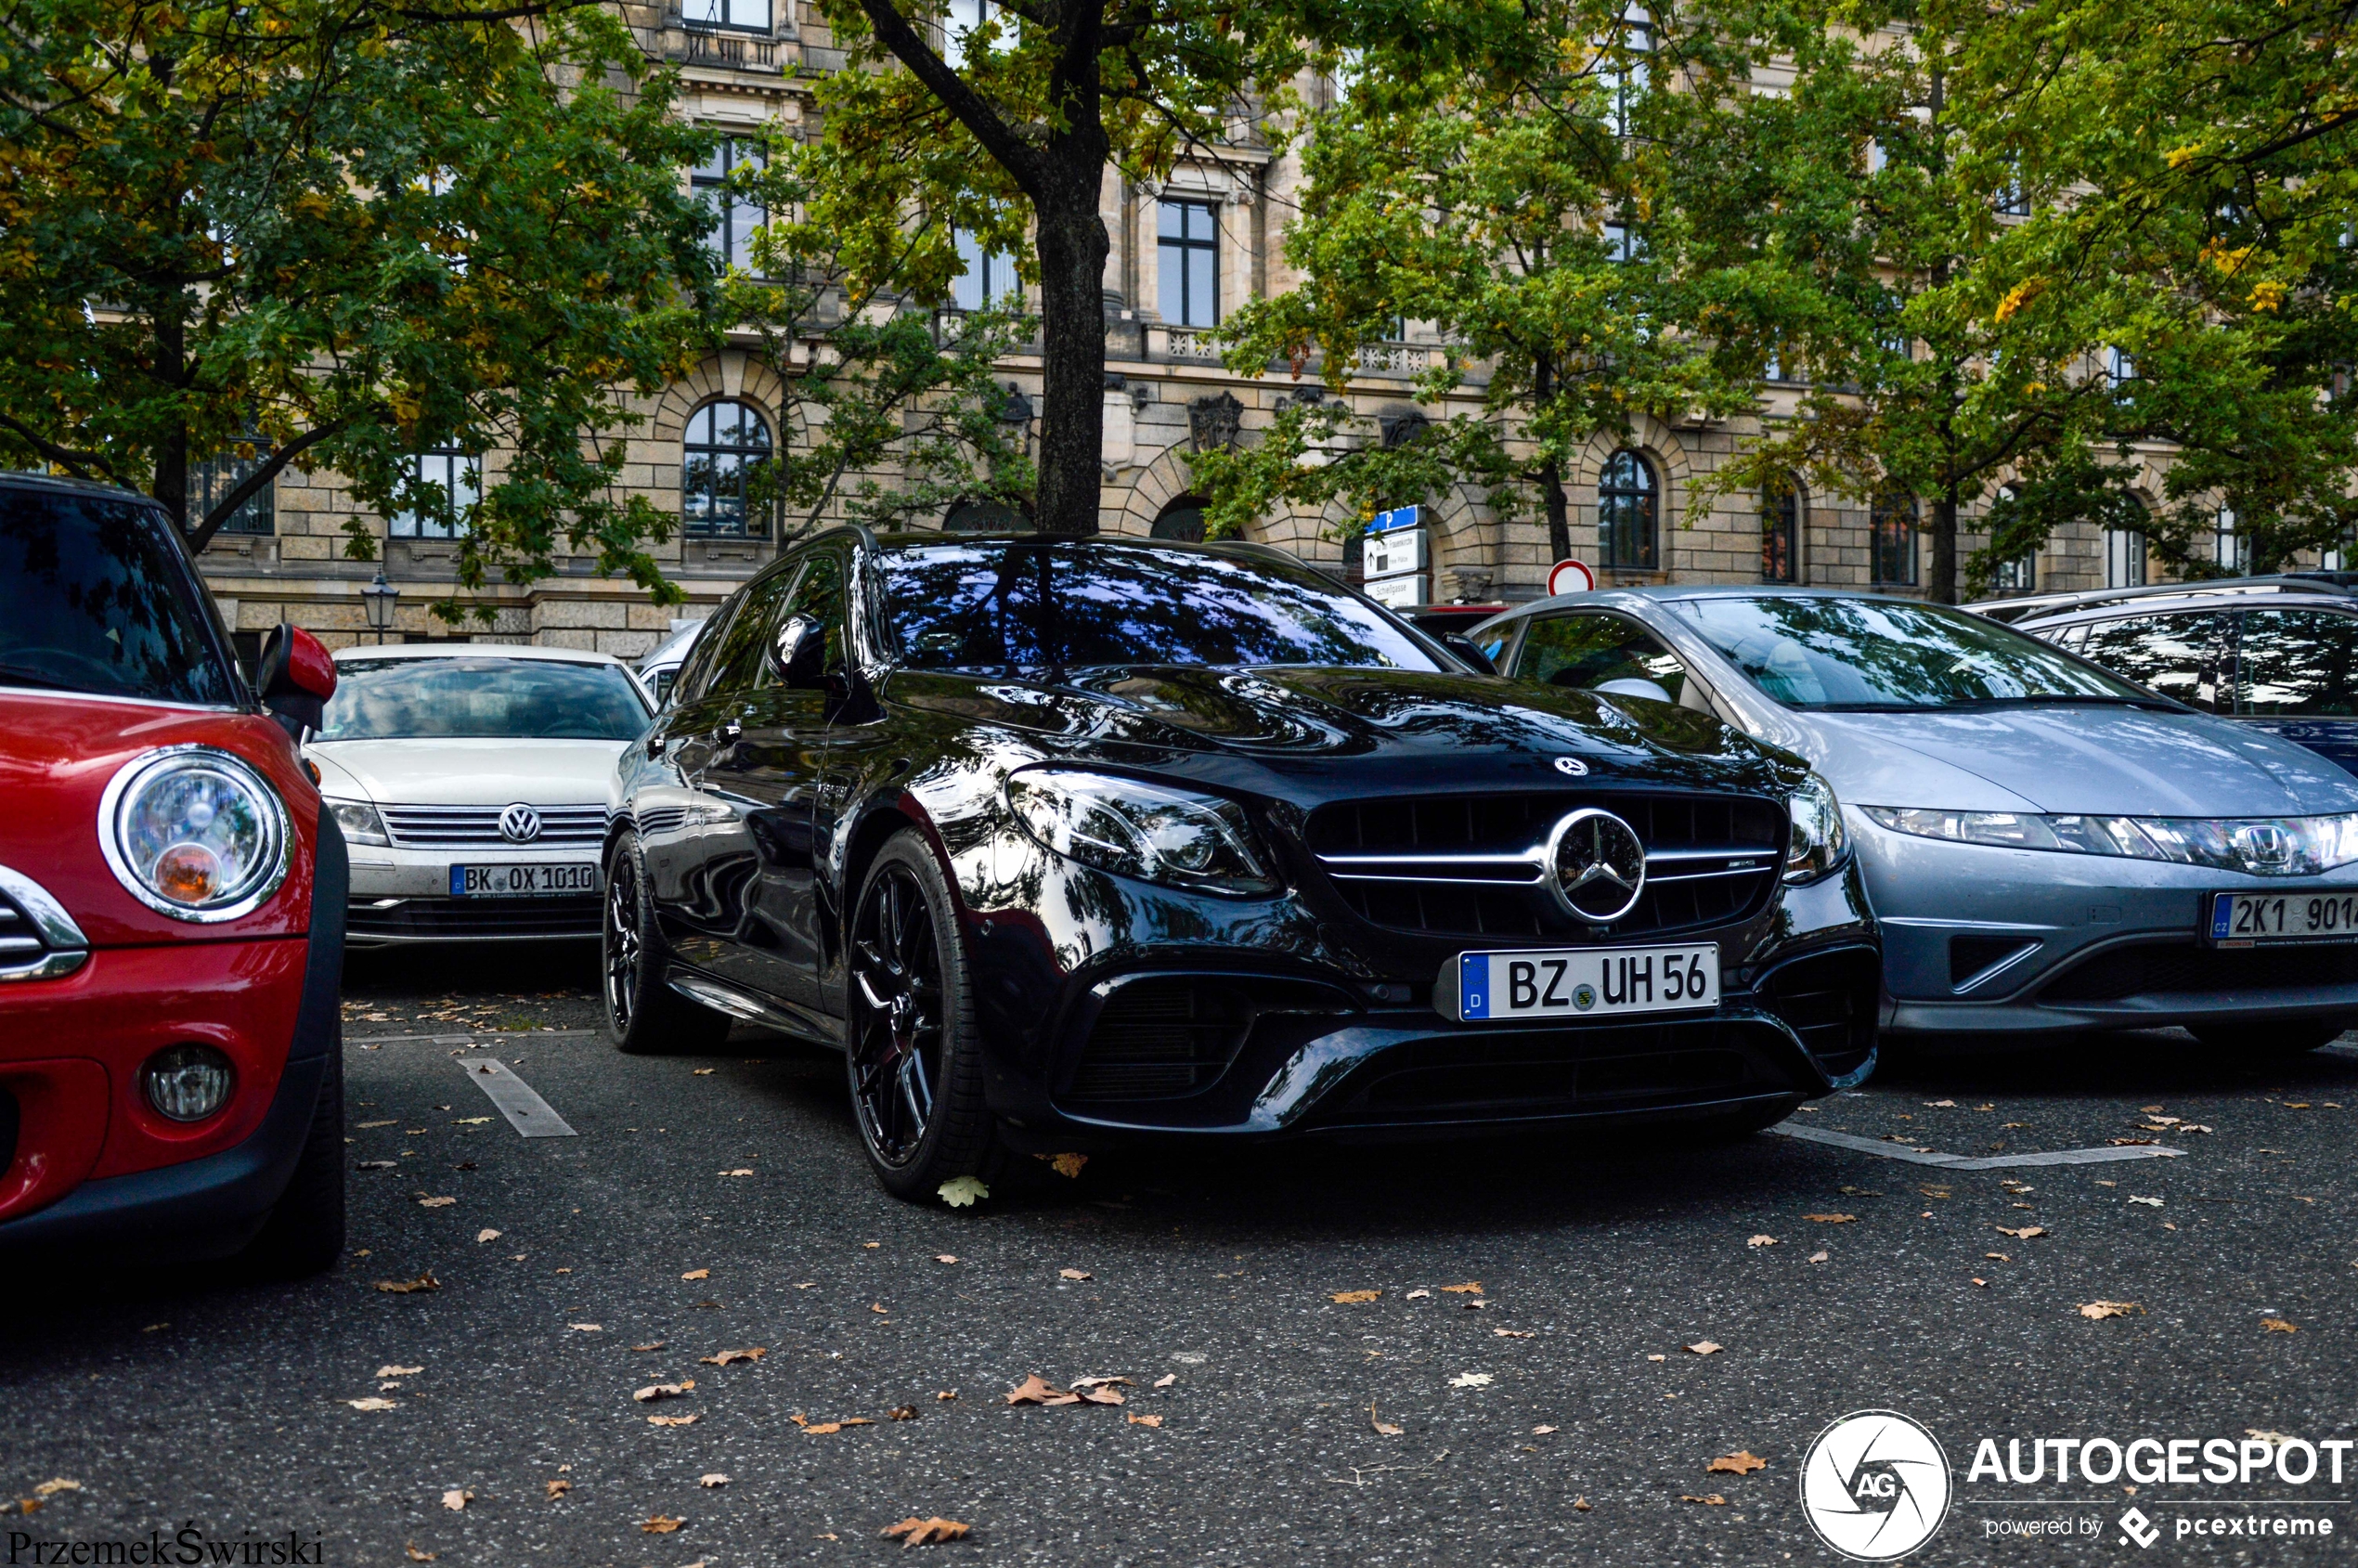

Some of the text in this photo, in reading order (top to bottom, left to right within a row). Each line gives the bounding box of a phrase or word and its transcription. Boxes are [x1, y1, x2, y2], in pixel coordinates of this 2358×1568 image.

[1386, 512, 1393, 529] P
[465, 868, 491, 890] BK
[541, 867, 591, 889] 1010
[2235, 899, 2286, 932] 2K1
[2214, 922, 2227, 932] CZ
[1509, 952, 1706, 1009] BZ UH 56
[1471, 994, 1481, 1008] D
